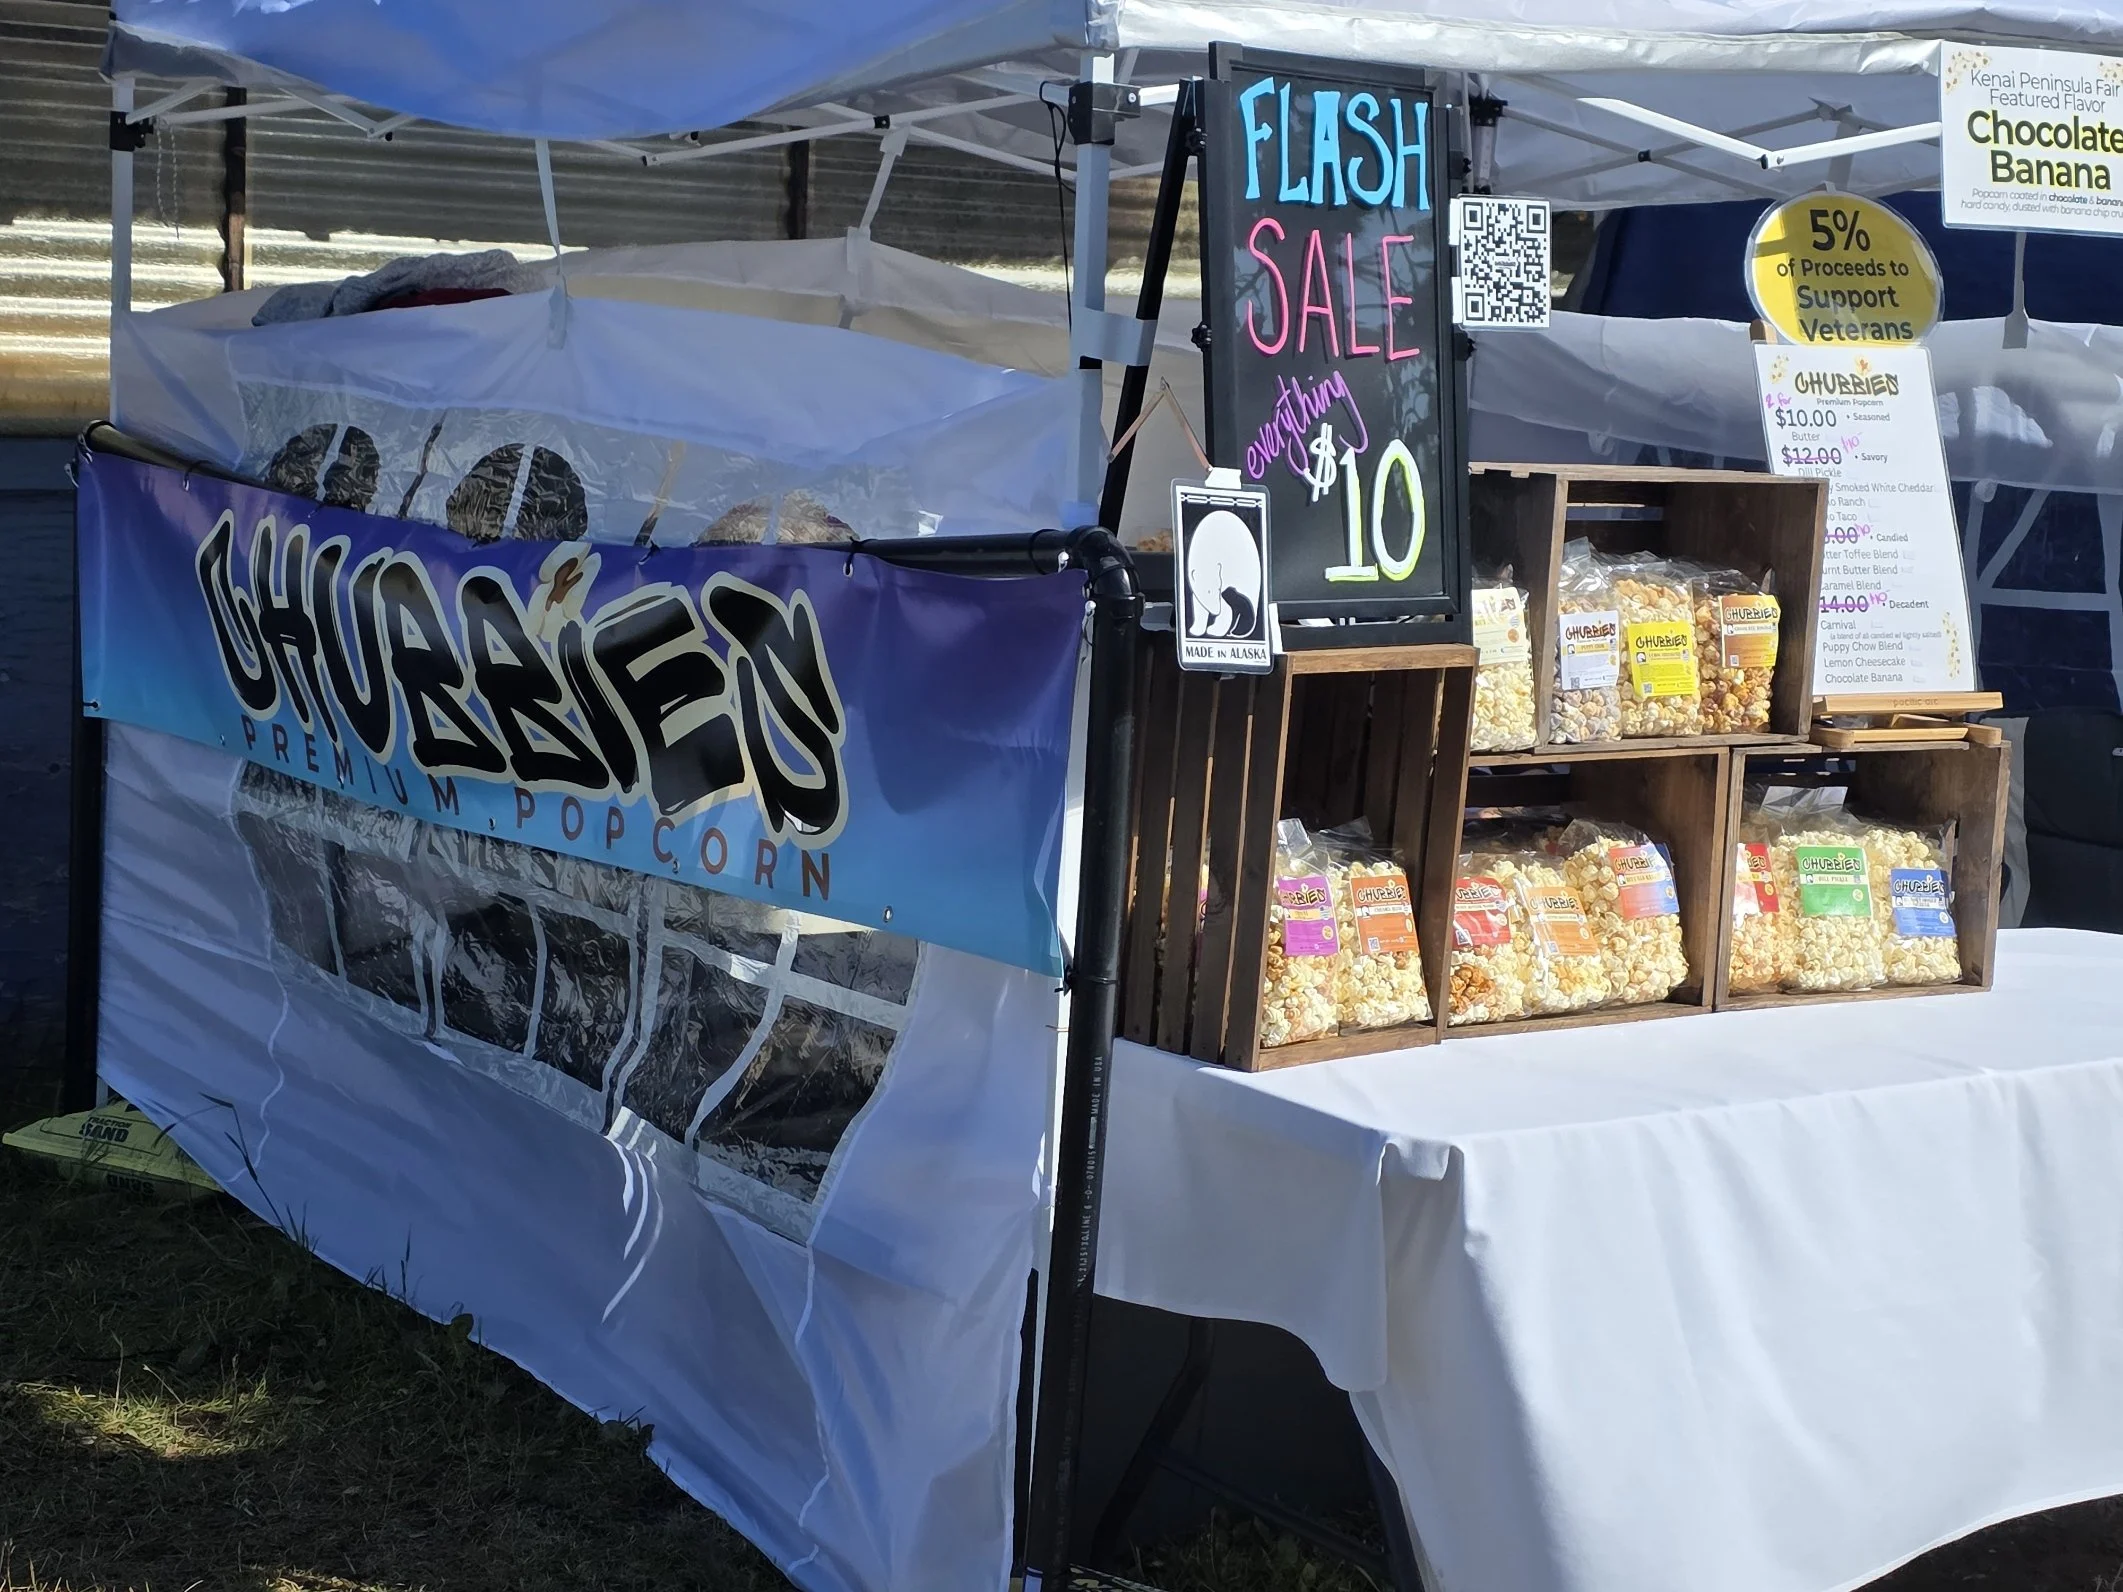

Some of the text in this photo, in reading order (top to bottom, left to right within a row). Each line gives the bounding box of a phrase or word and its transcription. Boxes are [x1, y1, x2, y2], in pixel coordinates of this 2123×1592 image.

[1970, 69, 2121, 97] Kenai Peninsula Fair
[1990, 89, 2106, 113] Featured Flavor
[1240, 76, 1430, 211] FLASH
[1990, 150, 2111, 190] Banana
[2049, 193, 2088, 204] chocolate
[1961, 200, 1982, 210] hard
[2012, 202, 2041, 212] dusted
[2043, 204, 2059, 213] with
[2060, 205, 2091, 216] banana
[2093, 208, 2109, 218] chip
[1810, 209, 1870, 252] 5%
[1777, 258, 1909, 277] of Proceeds to
[1248, 217, 1420, 361] SALE
[1797, 285, 1900, 314] Support
[1799, 318, 1913, 342] Veterans
[1795, 371, 1899, 396] CHUBBIES
[1777, 392, 1792, 407] for
[1817, 398, 1884, 408] Premium Popcorn
[1246, 370, 1369, 480] everything
[1775, 407, 1890, 430] $10.00 Seasoned
[1792, 432, 1820, 442] Butter
[1782, 445, 1888, 467] $12.00 Savory
[1816, 468, 1842, 478] Pickle
[1835, 483, 1869, 493] Smoked
[1872, 483, 1896, 493] White
[1898, 483, 1933, 493] Cheddar
[1305, 422, 1426, 582] $10
[1839, 497, 1865, 507] Ranch
[1837, 512, 1857, 521] Taco
[1876, 533, 1908, 543] Candied
[1843, 549, 1871, 559] Toffee
[1873, 549, 1898, 559] Blend
[1823, 565, 1898, 575] urnt Butter Blend
[1821, 580, 1881, 591] aramel Blend
[1820, 595, 1929, 613] 14.00 Decadent
[1565, 621, 1616, 641] CHUBBIES
[1820, 619, 1856, 630] Carnival
[1636, 634, 1688, 649] CHUBBIES
[1823, 641, 1903, 653] Puppy Chow Blend
[1186, 645, 1267, 660] MADE IN ALASKA
[1824, 657, 1906, 668] Lemon Cheesecake
[195, 507, 848, 849] CHUBBIES
[1825, 673, 1903, 683] Chocolate Banana
[241, 715, 832, 901] PREMIUM POPCORN
[1802, 858, 1861, 871] CHUBBIES
[1094, 1056, 1103, 1072] USA
[1093, 1076, 1101, 1087] IN
[87, 1116, 133, 1129] TRACTION
[79, 1123, 130, 1144] SAND
